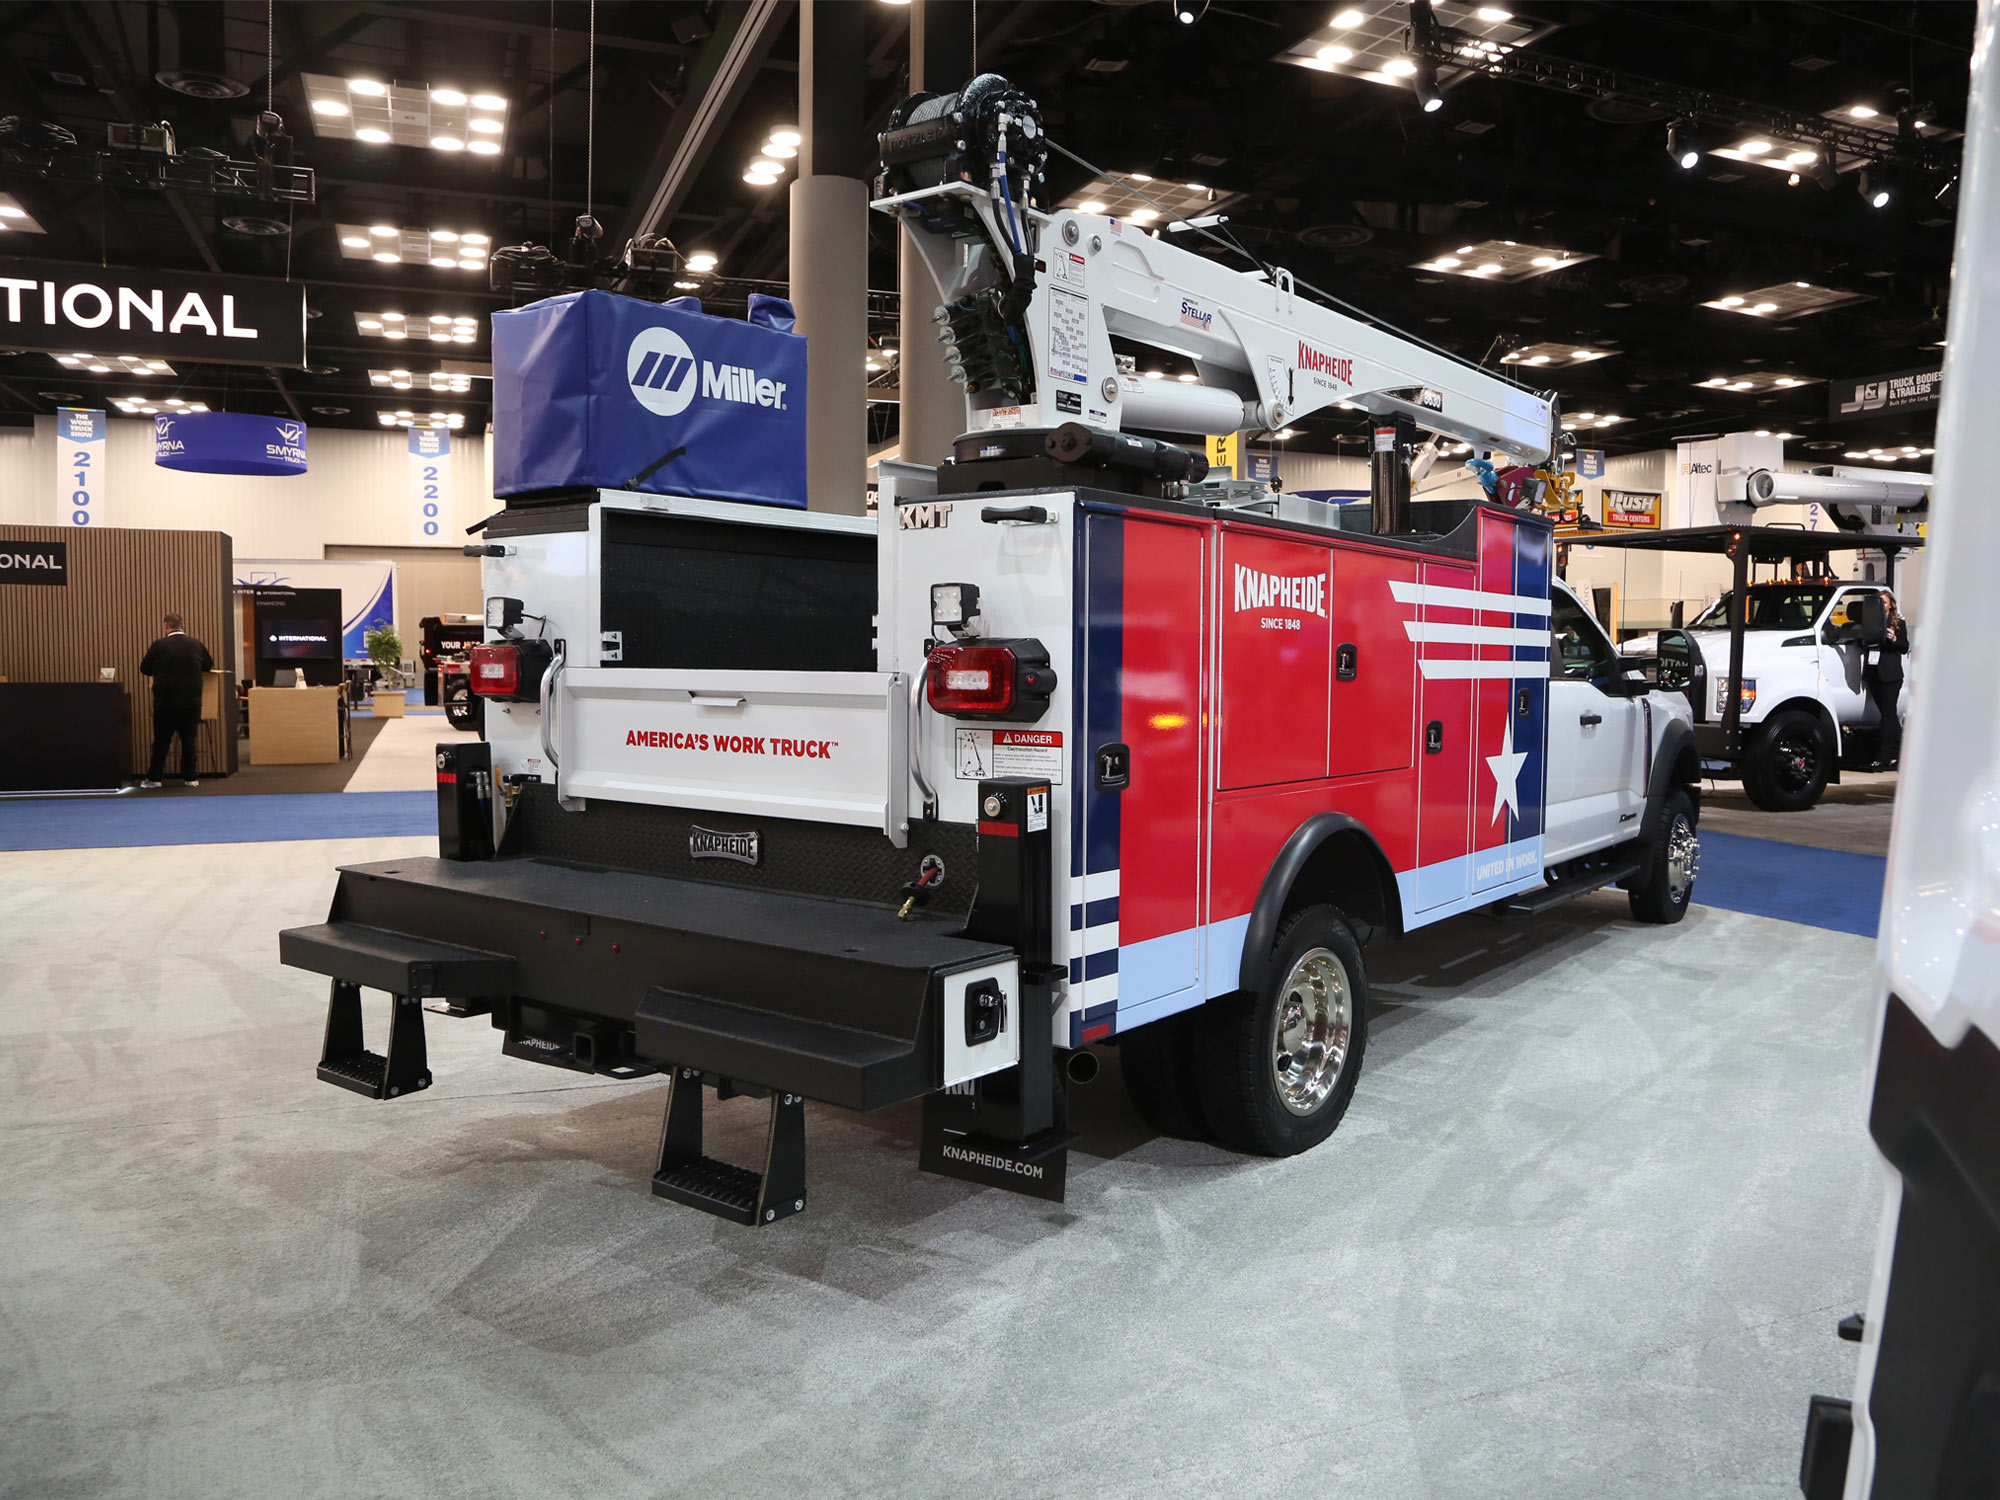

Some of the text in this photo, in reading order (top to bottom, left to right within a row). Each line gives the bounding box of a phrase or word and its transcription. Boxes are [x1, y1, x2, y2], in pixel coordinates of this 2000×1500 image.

[0, 277, 258, 338] TIONAL
[1181, 301, 1212, 324] STELLAR
[1298, 340, 1353, 387] KNAPHEIDE
[1313, 377, 1338, 391] SINCE 1848
[1889, 371, 1944, 389] TRUCK BODIES
[1691, 463, 1712, 474] Altec
[899, 504, 953, 530] KMT
[1612, 513, 1651, 523] TRUCK CENTERS
[1234, 563, 1327, 618] KNAPHEIDE
[1260, 617, 1301, 630] SINCE 1848
[441, 641, 461, 649] YOUR
[625, 730, 709, 751] AMERICA'S
[713, 735, 765, 755] WORK
[1014, 734, 1053, 744] DANGER
[692, 831, 755, 860] KNAPHEIDE
[1476, 860, 1504, 881] UNITED
[1505, 856, 1514, 873] IN
[943, 1145, 1044, 1179] KNAPHEIDE.COM
